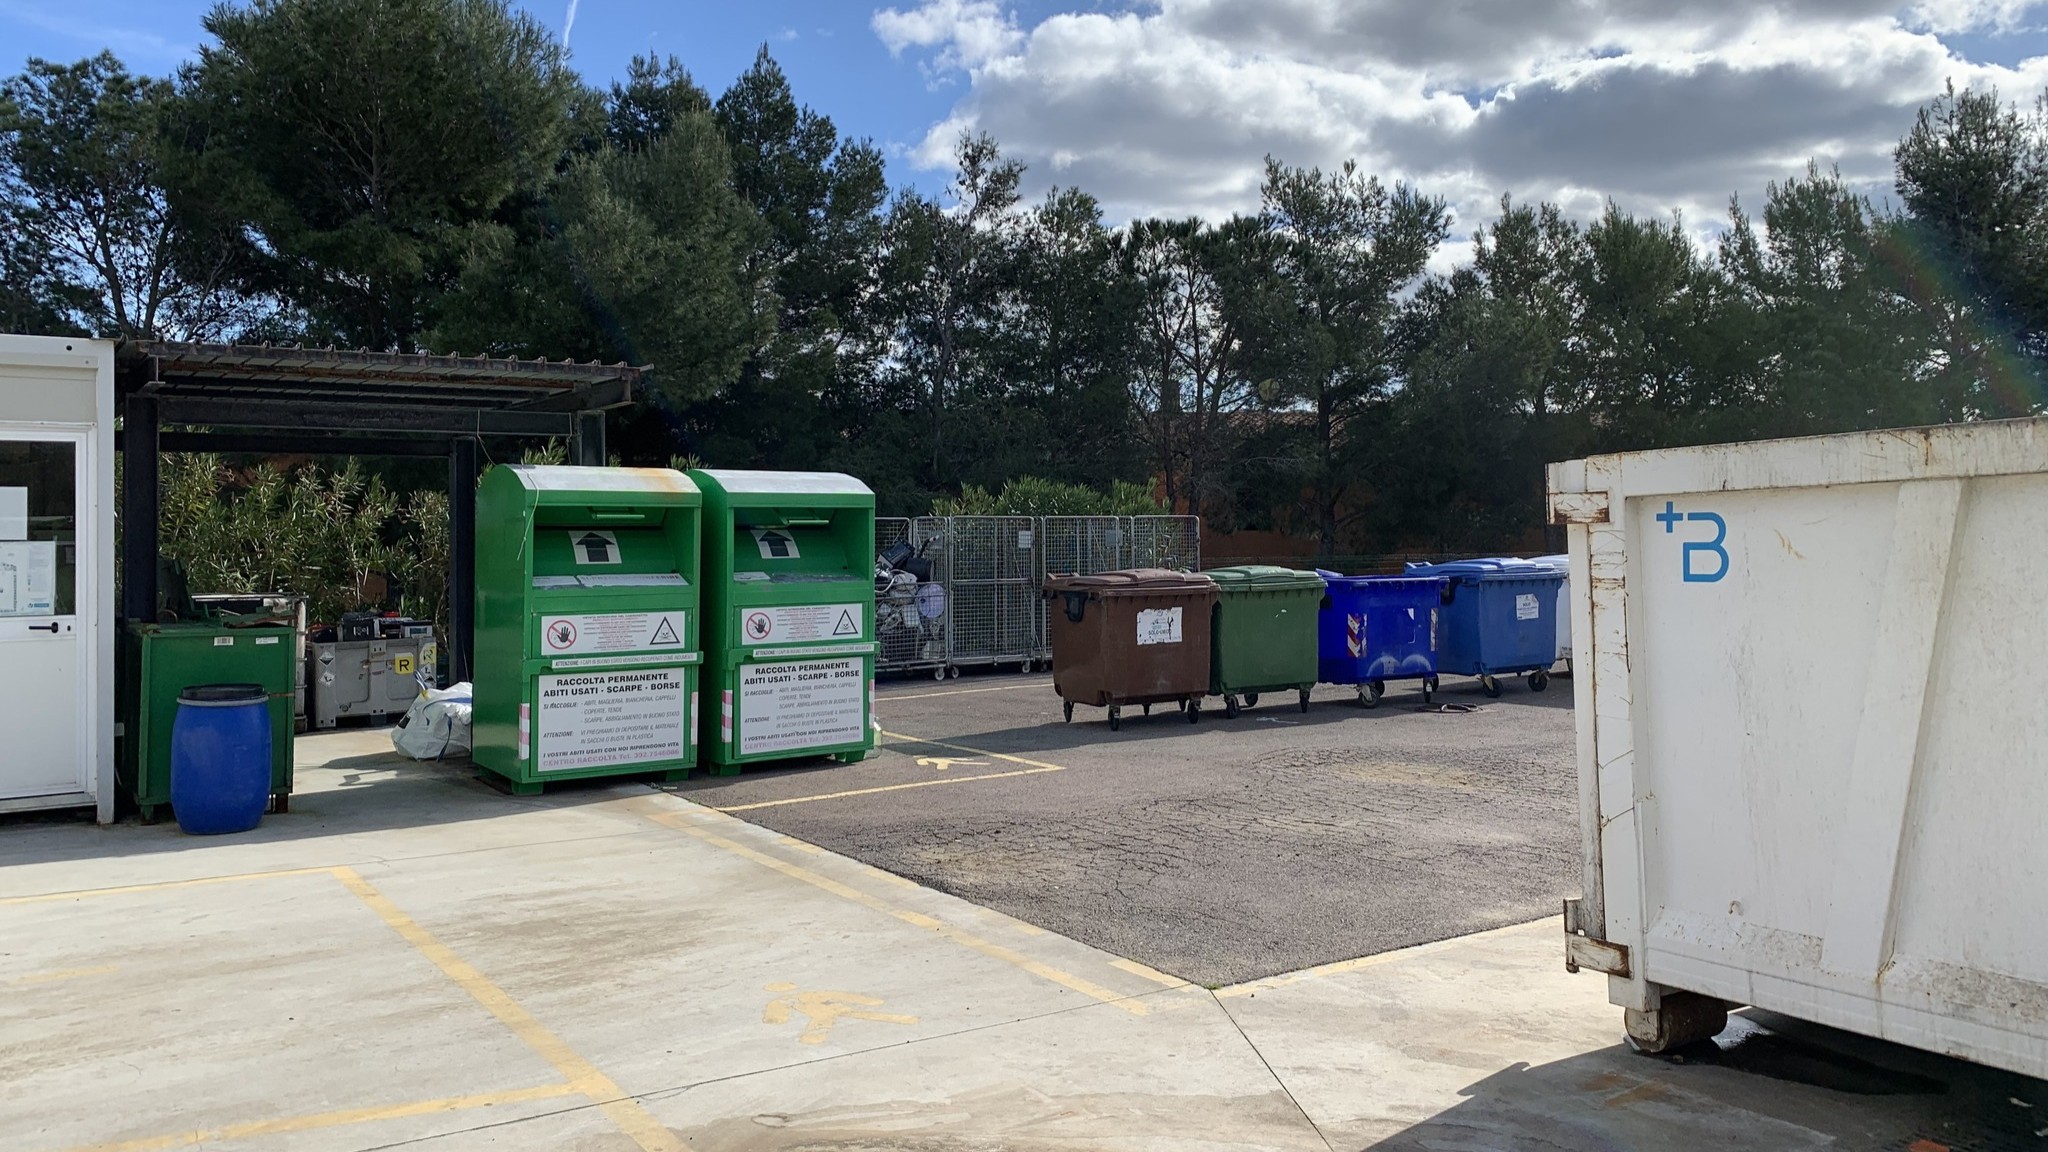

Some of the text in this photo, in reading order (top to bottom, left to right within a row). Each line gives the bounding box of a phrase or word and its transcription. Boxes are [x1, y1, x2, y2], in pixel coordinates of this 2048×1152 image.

[400, 659, 409, 672] R
[756, 662, 849, 674] RACCOLTA PERMANENTE
[557, 673, 668, 686] RACCOLTA PERMANENTE
[544, 689, 570, 697] ABITI
[572, 687, 598, 695] USATI
[607, 684, 642, 693] SCARPE
[651, 682, 680, 690] BORSE
[543, 759, 574, 767] CENTRO
[577, 755, 617, 764] RACCOLTA
